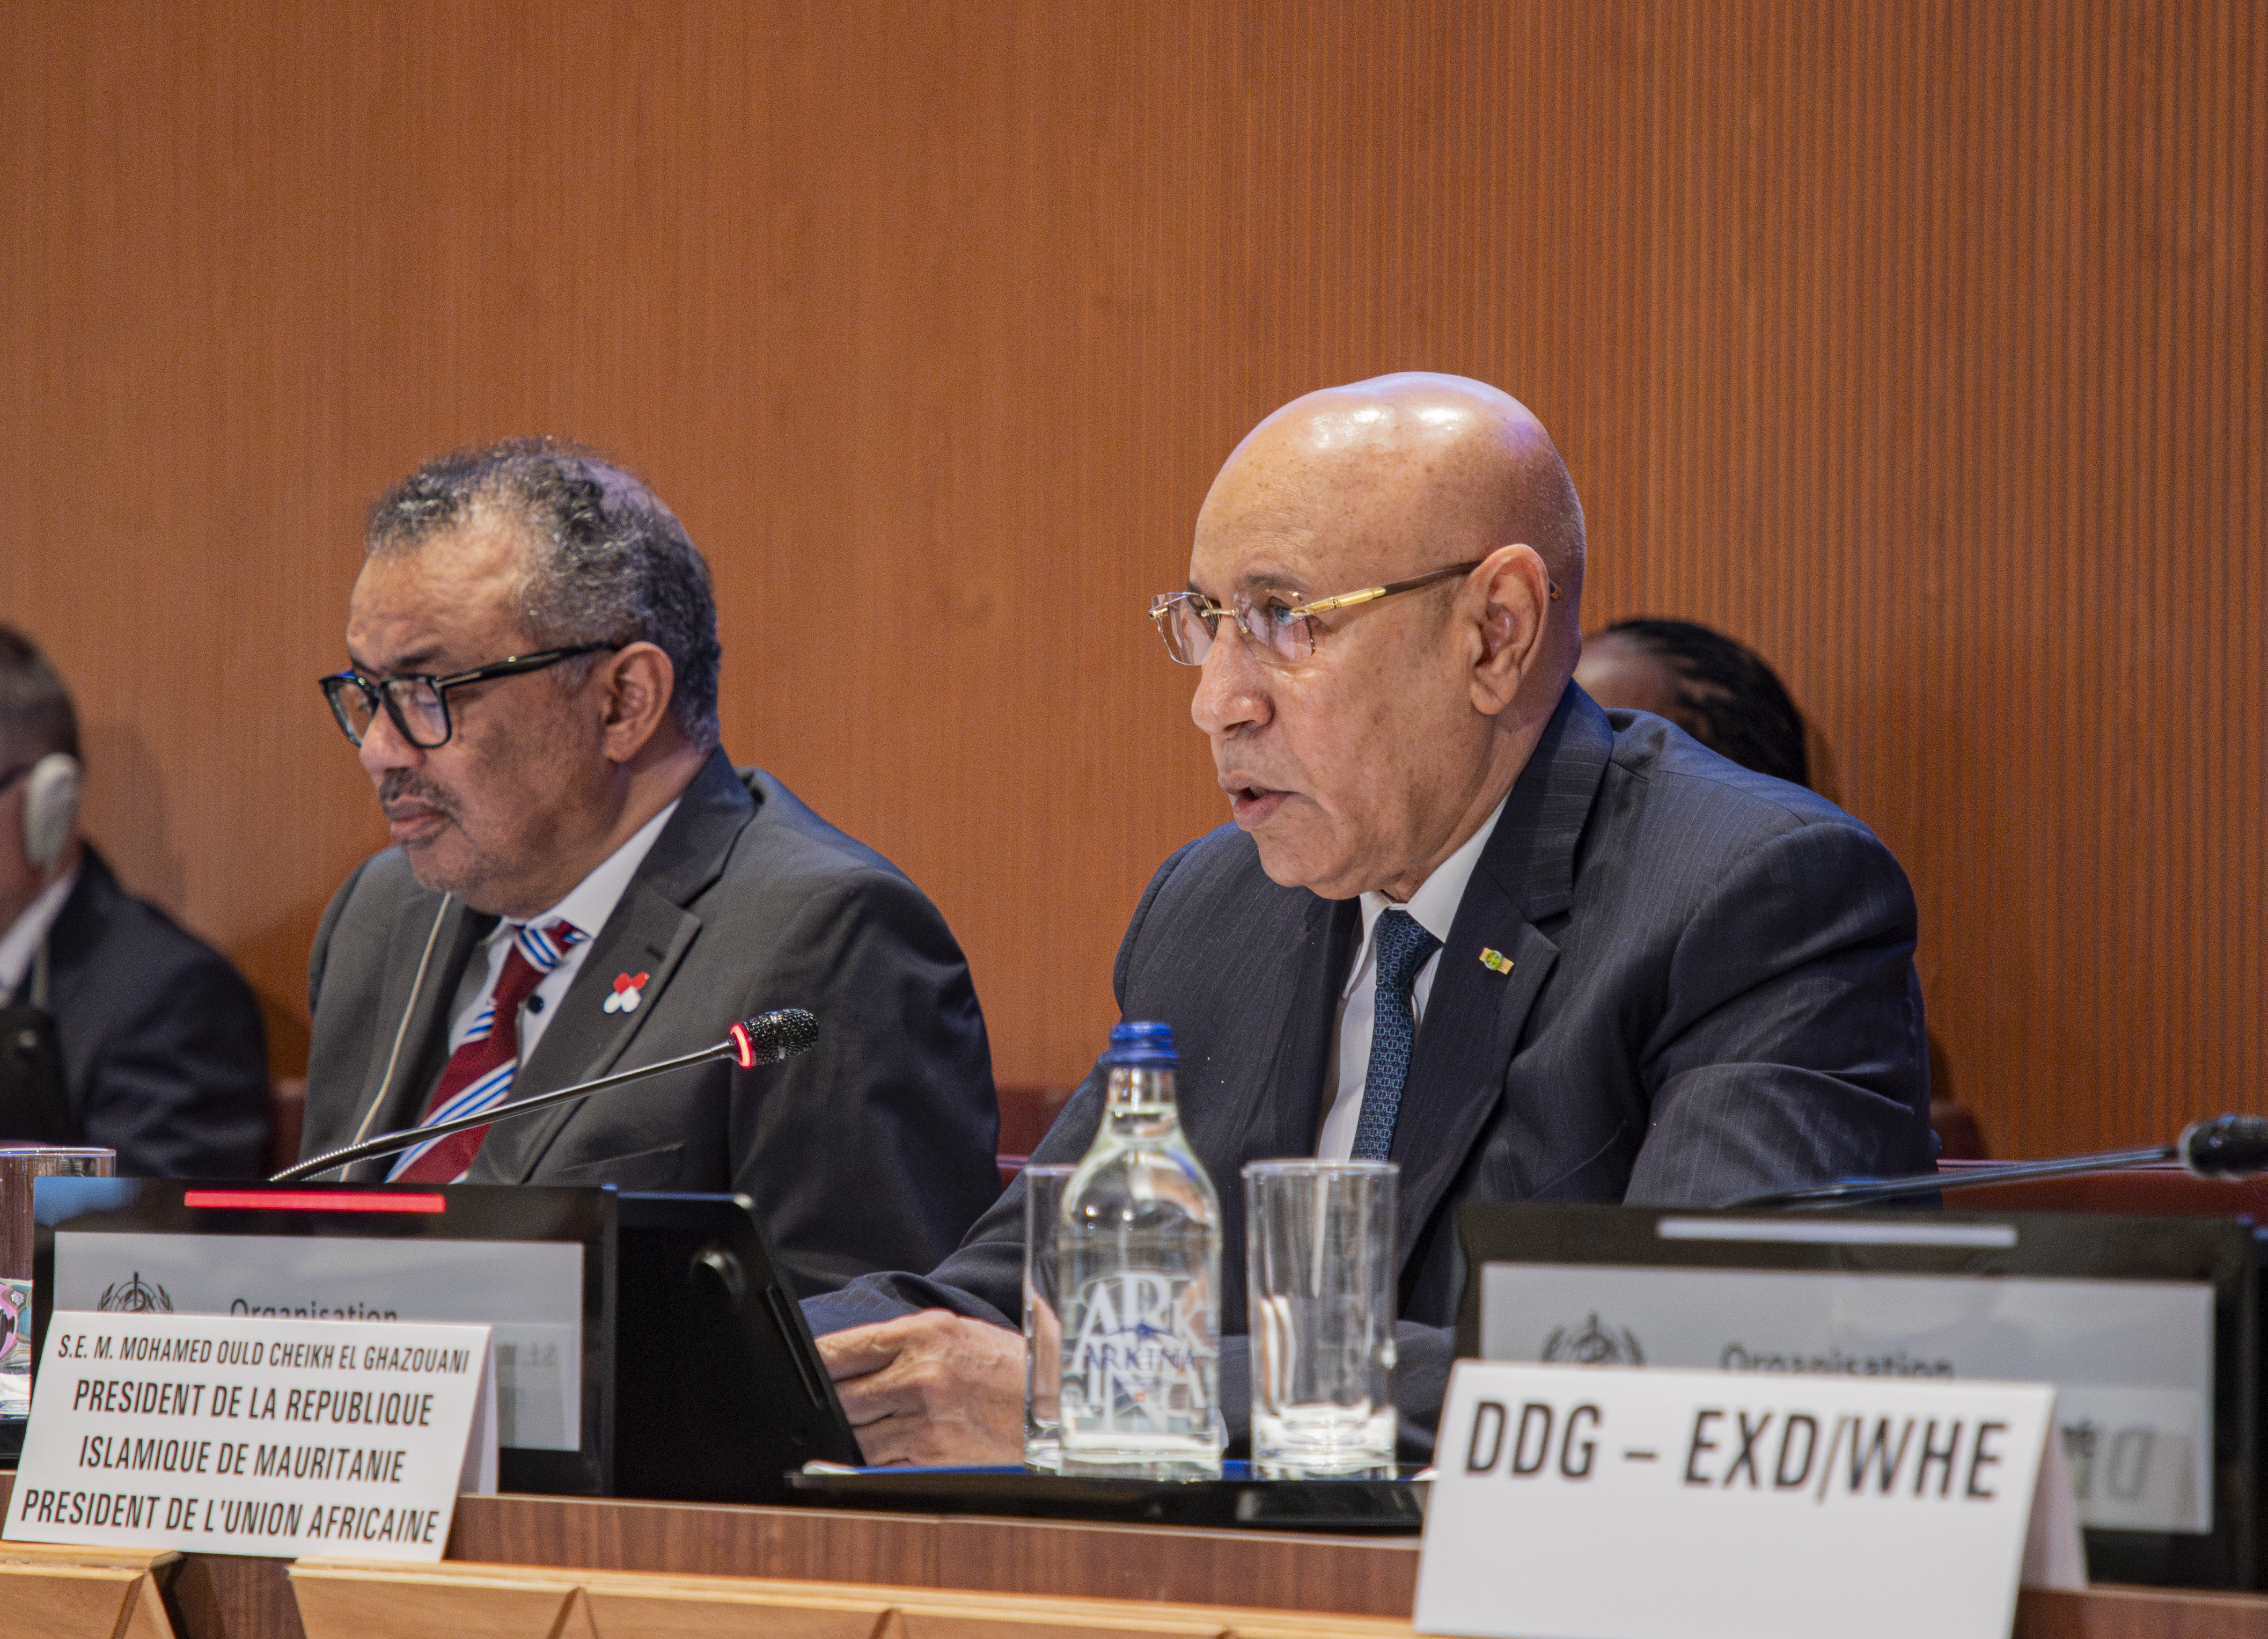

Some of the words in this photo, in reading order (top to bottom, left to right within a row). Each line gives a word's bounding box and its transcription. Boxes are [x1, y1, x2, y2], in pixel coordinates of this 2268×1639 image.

[58, 1335, 87, 1358] S.E.
[93, 1336, 113, 1359] M.
[119, 1336, 211, 1363] MOHAMED
[216, 1340, 263, 1365] OULD
[269, 1342, 334, 1369] CHEIKH
[339, 1345, 356, 1370] EL
[363, 1346, 469, 1374] GHAZOUANI
[73, 1379, 205, 1416] PRESIDENT
[210, 1385, 243, 1417] DE
[248, 1387, 276, 1420] LA
[284, 1389, 434, 1426] REPUBLIQUE
[78, 1436, 211, 1473] ISLAMIQUE
[216, 1442, 249, 1475] DE
[253, 1444, 406, 1483] MAURITANIE
[1465, 1401, 1602, 1480] DDG
[1682, 1410, 2009, 1503] EXD/WHE
[21, 1489, 160, 1530] PRESIDENT
[165, 1497, 199, 1531] DE
[204, 1499, 303, 1537] L'UNION
[306, 1505, 439, 1543] AFRICAINE
